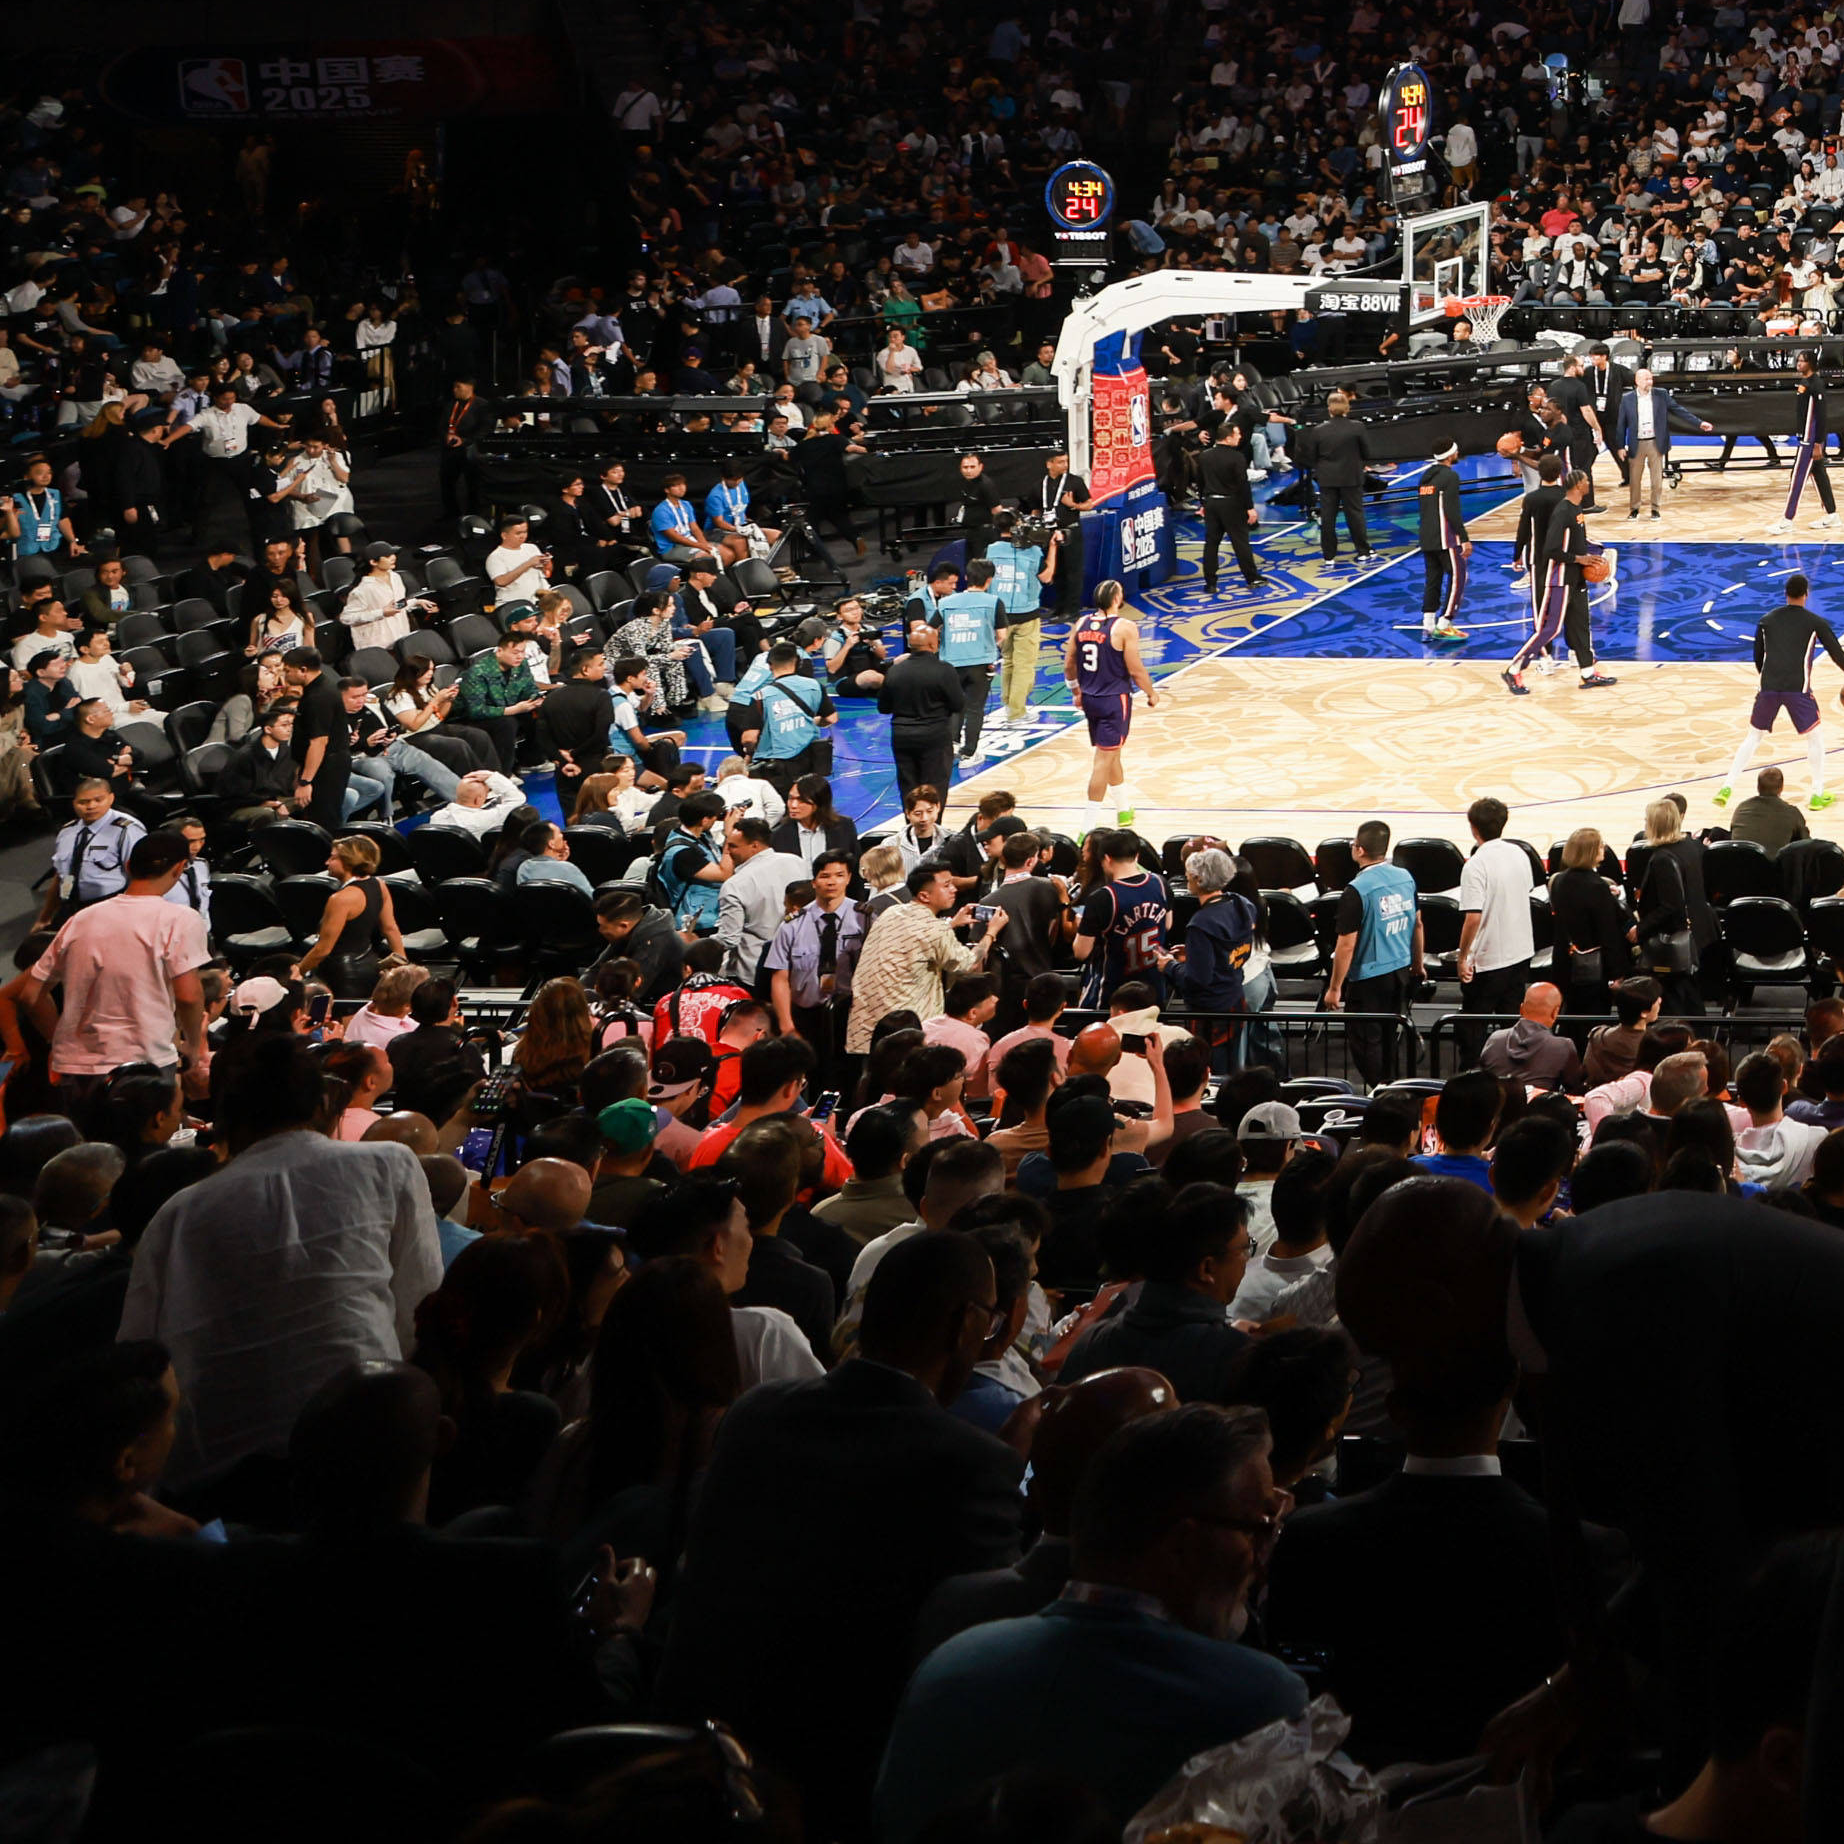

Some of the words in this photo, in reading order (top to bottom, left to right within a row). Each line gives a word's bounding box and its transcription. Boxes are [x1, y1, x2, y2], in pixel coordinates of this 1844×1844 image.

[262, 87, 371, 111] 2025
[1395, 106, 1423, 148] 24
[1401, 160, 1426, 175] TISSOT
[1068, 181, 1103, 196] 4:34
[1066, 197, 1098, 220] 24
[1069, 232, 1107, 240] TISSOT
[1136, 538, 1155, 560] 2025
[1084, 644, 1098, 672] 3
[1114, 902, 1167, 935] CARTER
[1125, 927, 1160, 972] 15
